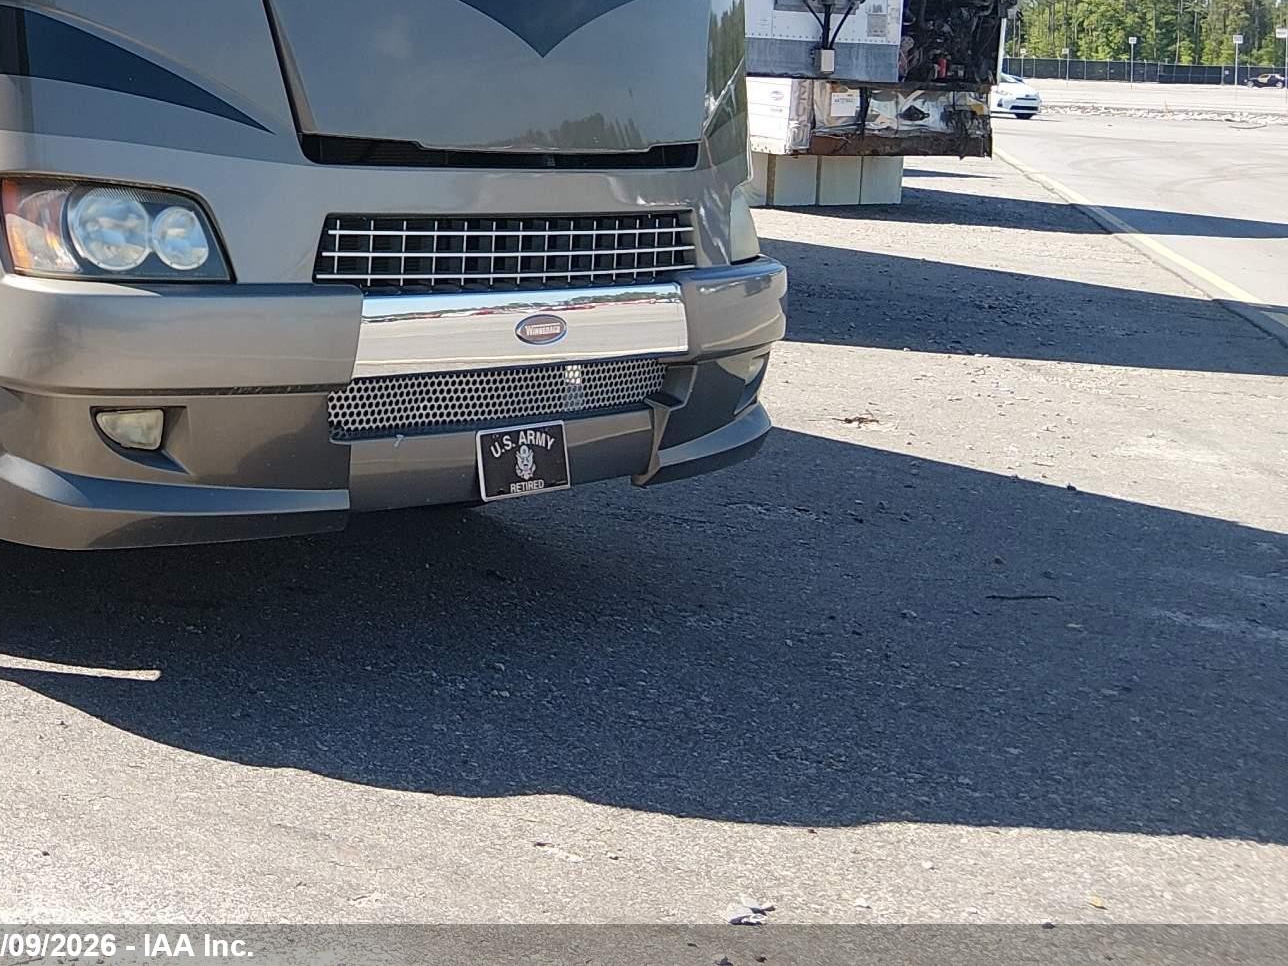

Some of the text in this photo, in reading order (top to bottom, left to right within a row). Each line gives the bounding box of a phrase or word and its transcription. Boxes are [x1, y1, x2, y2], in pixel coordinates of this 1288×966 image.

[490, 429, 556, 458] U.S. ARMY
[510, 479, 545, 494] RETIRED
